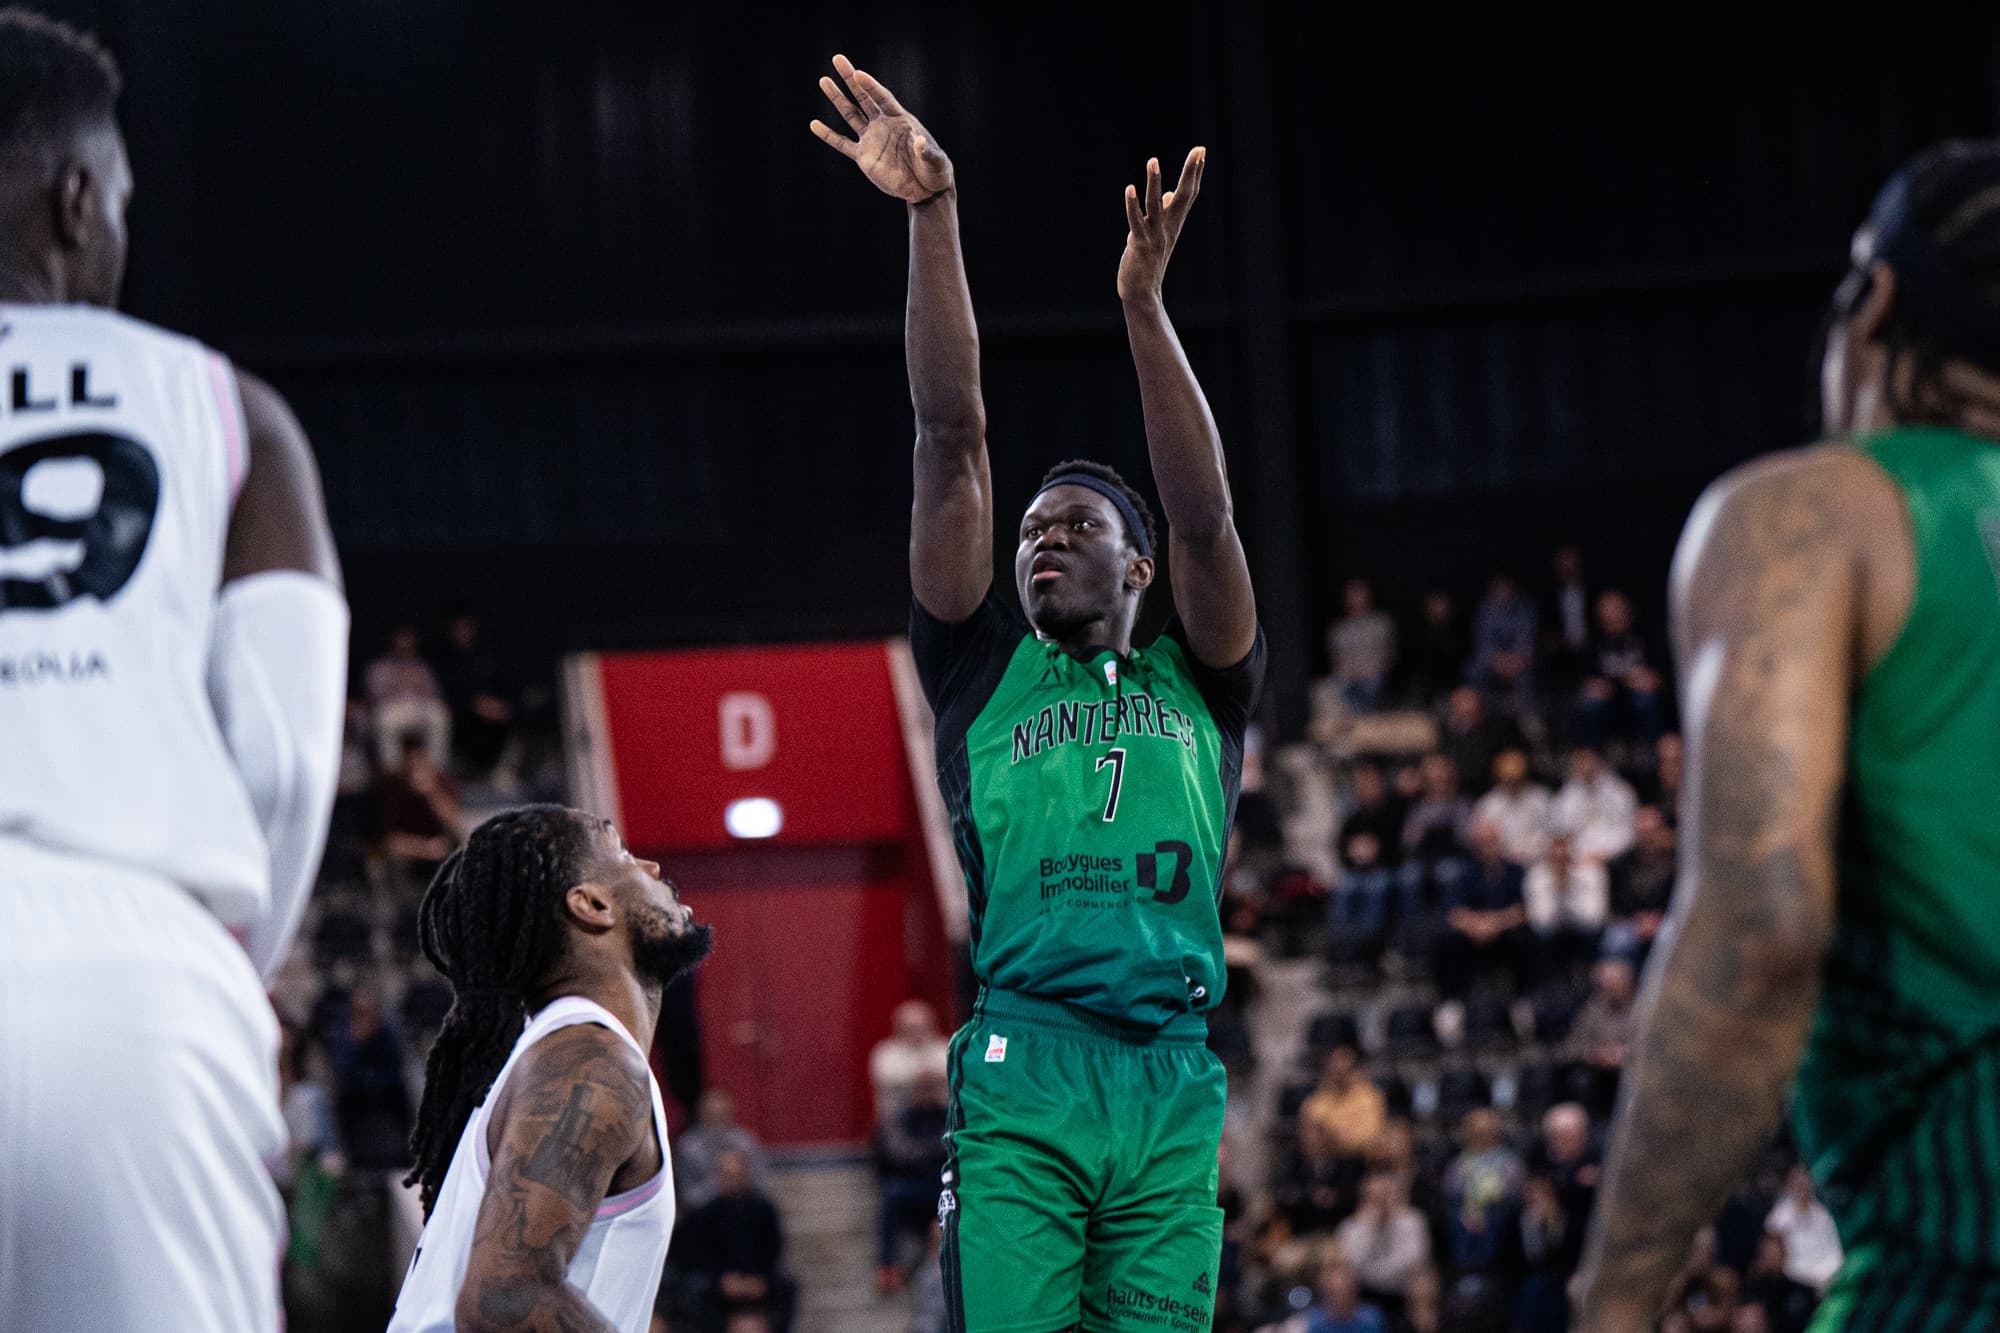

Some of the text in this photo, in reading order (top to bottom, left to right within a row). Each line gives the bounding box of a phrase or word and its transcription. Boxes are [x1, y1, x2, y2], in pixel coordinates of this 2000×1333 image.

[0, 430, 162, 613] 9
[718, 691, 776, 771] D
[1095, 747, 1126, 822] 7
[1039, 853, 1123, 878] Bouygues
